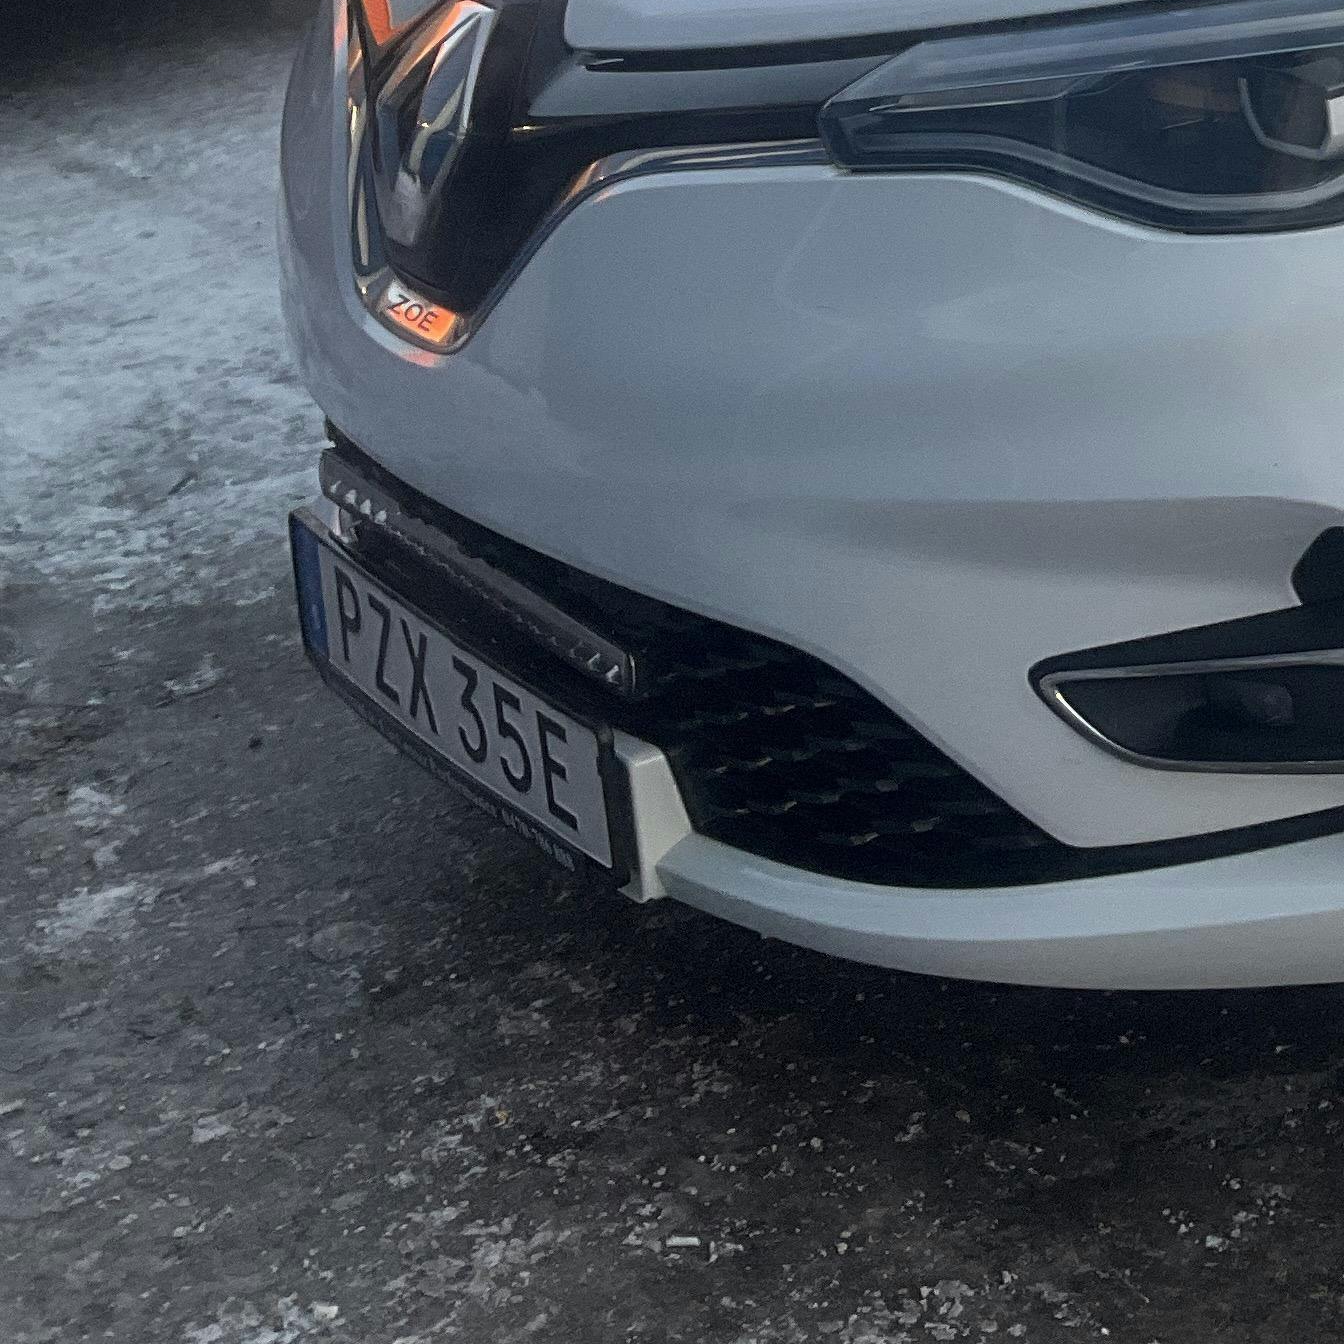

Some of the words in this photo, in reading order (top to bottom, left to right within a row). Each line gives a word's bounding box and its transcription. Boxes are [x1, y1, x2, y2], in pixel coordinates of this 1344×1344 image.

[387, 294, 438, 331] ZOE
[334, 565, 439, 736] PZX
[452, 655, 580, 832] 35E
